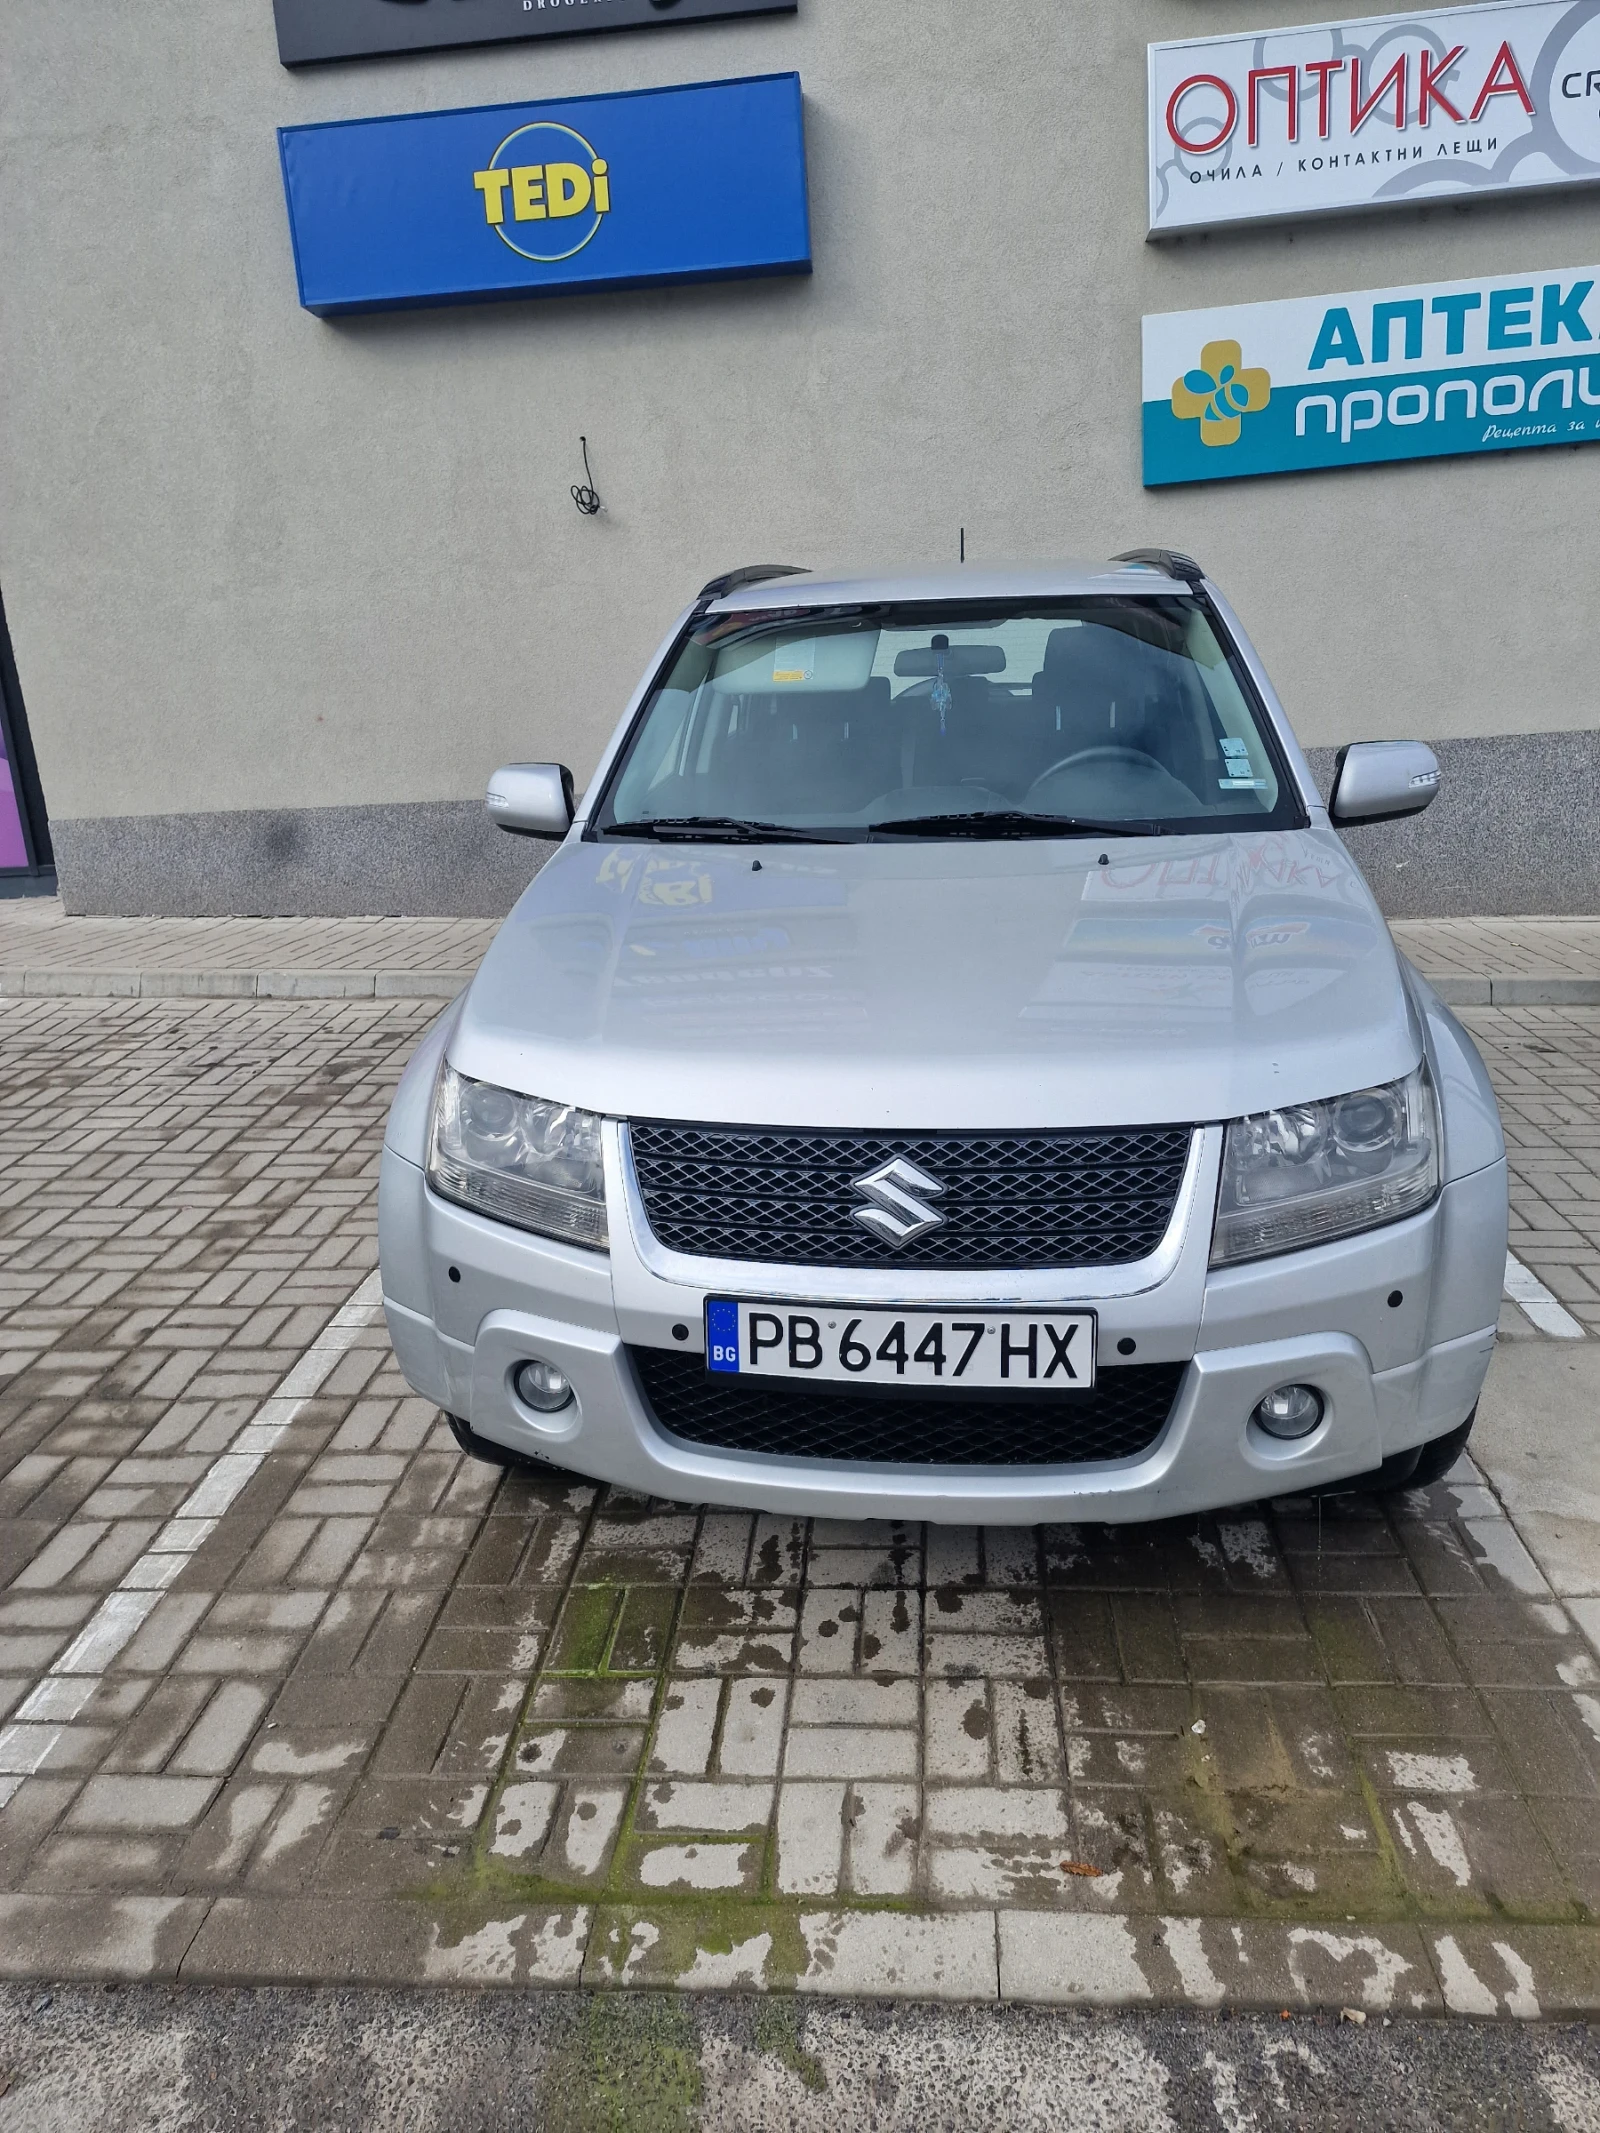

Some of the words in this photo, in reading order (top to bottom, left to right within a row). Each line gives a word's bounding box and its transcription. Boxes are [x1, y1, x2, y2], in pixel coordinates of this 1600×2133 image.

[1166, 40, 1536, 155] ОПТИКА
[473, 158, 610, 224] TEDi
[1189, 164, 1263, 184] ОЧИЛА
[1276, 161, 1284, 176] /
[1298, 147, 1423, 172] КОНТАКТНИ
[1437, 137, 1498, 156] ЛЕЩИ
[1307, 280, 1600, 371] АПТЕК
[1482, 423, 1557, 443] Рецепта
[1567, 420, 1586, 432] за
[713, 1345, 737, 1363] BG
[749, 1312, 823, 1369] PB
[838, 1318, 985, 1377] 6447
[1000, 1323, 1079, 1379] HX
